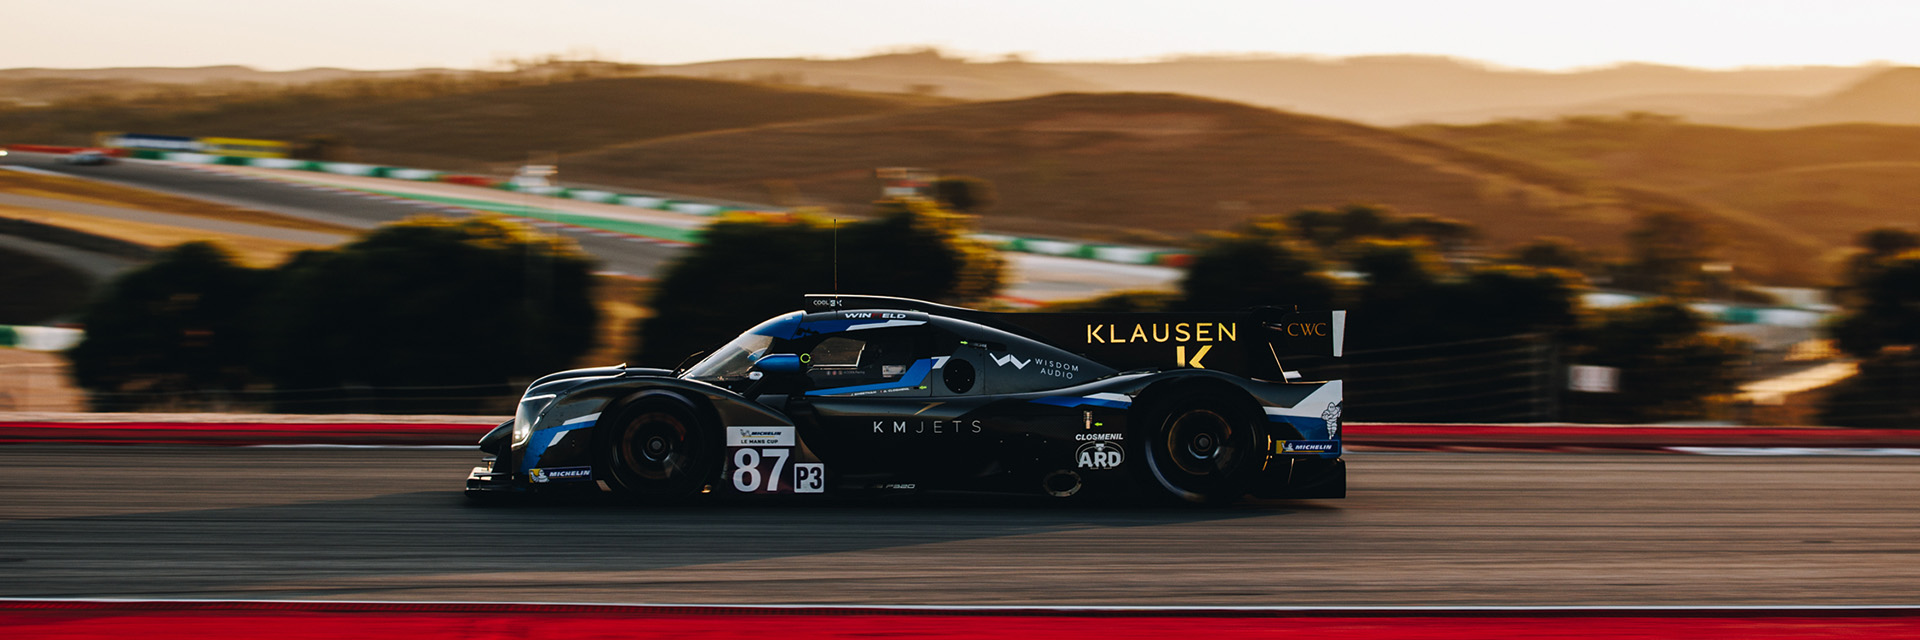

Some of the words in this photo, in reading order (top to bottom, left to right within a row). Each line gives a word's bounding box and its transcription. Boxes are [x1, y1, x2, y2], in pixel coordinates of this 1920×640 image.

[1087, 322, 1237, 344] KLAUSEN
[1287, 322, 1327, 337] CWC
[1034, 358, 1079, 372] WISDOM
[1040, 367, 1073, 380] AUDIO
[1075, 433, 1124, 441] CLOSMENIL
[1077, 451, 1122, 468] ARD
[732, 447, 790, 492] 87
[796, 466, 822, 490] P3
